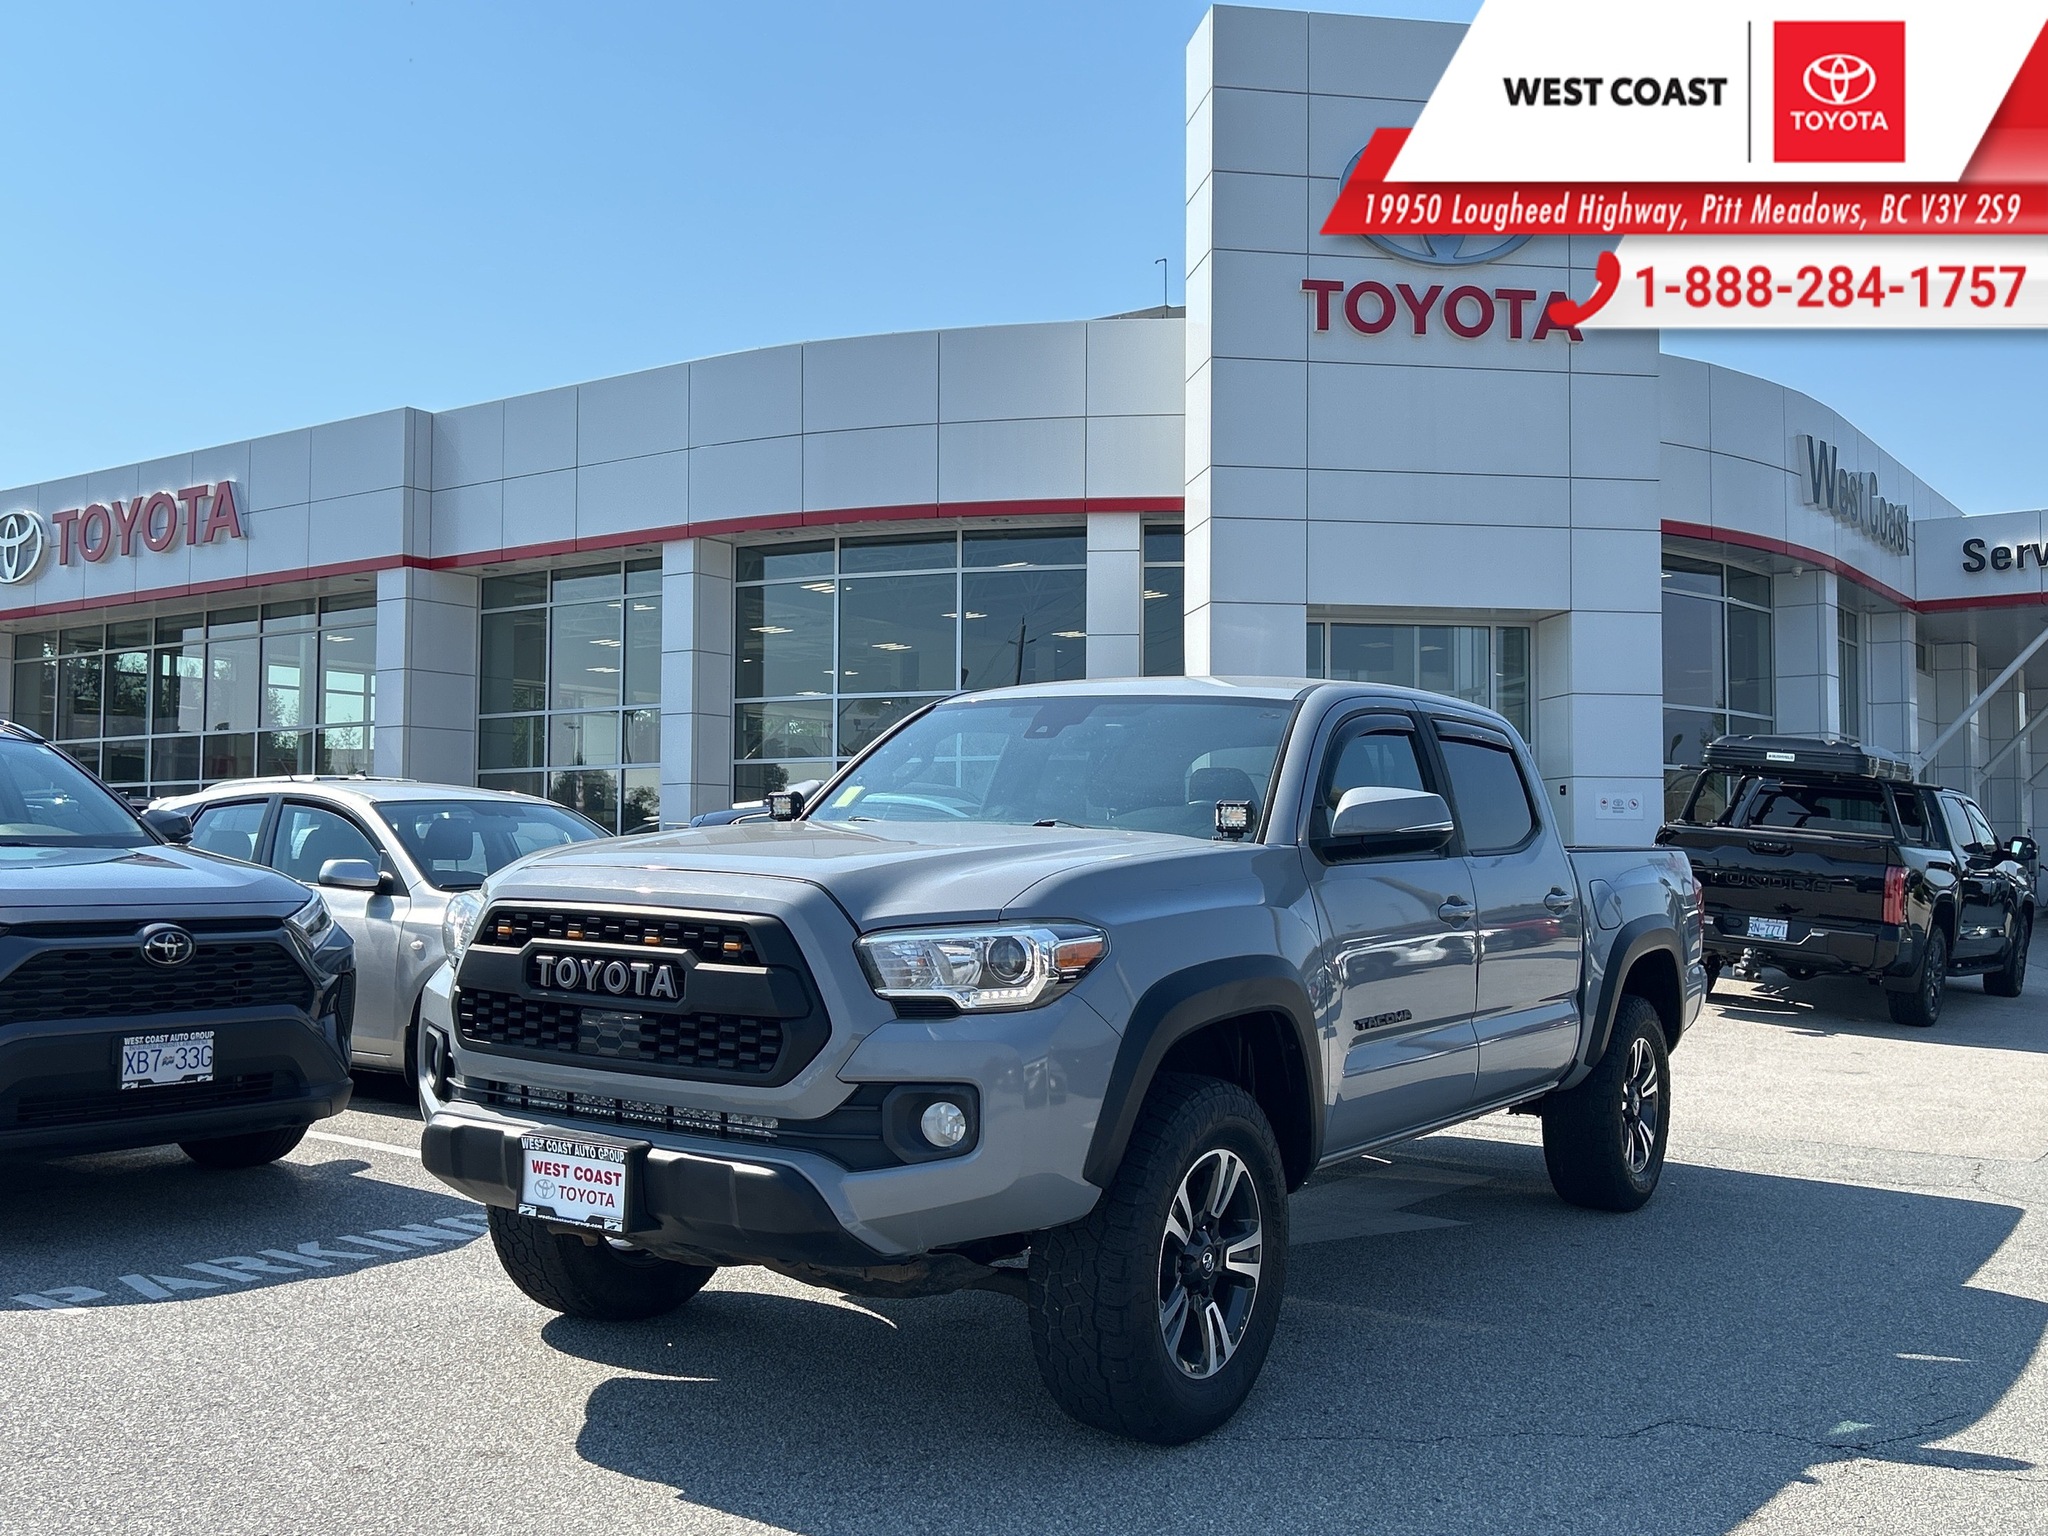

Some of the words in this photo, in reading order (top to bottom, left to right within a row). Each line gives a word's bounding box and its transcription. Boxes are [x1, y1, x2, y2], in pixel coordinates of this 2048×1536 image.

[1301, 279, 1584, 343] TOYOTA
[1800, 434, 1864, 525] West
[1867, 471, 1910, 556] Coast
[52, 480, 246, 566] TOYOTA
[1962, 538, 2048, 573] Serv
[536, 955, 678, 998] TOYOTA
[1353, 1009, 1412, 1031] TACOMA
[124, 1036, 144, 1045] WEST
[145, 1034, 169, 1044] COAST
[170, 1032, 189, 1041] AUTO
[190, 1030, 215, 1040] GROUP
[124, 1049, 162, 1075] XB7
[521, 1137, 545, 1150] WEST
[546, 1140, 573, 1155] COAST
[574, 1144, 596, 1158] AUTO
[598, 1148, 625, 1163] GROUP
[532, 1159, 570, 1178] WEST
[574, 1166, 622, 1186] COAST
[558, 1185, 615, 1208] TOYOTA
